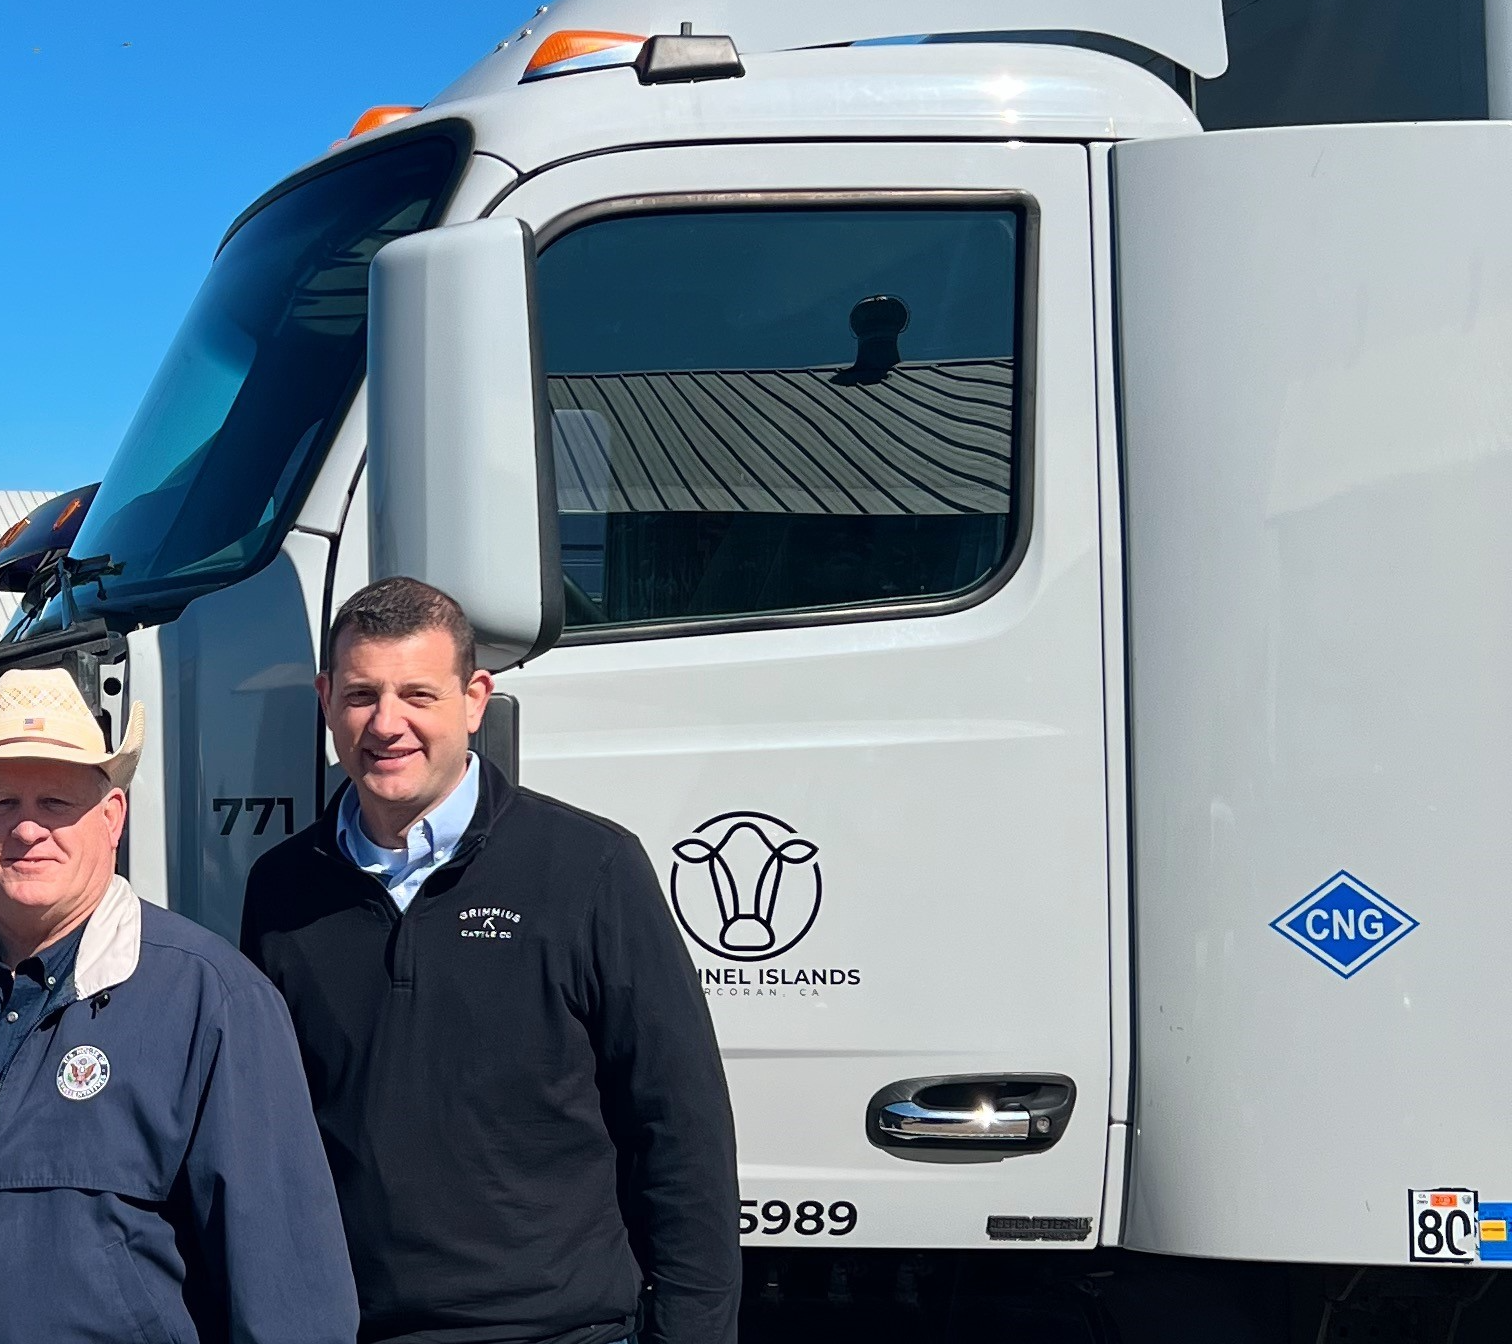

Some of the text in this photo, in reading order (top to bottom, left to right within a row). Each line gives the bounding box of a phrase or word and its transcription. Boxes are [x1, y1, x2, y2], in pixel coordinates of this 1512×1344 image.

[213, 797, 294, 836] 771
[460, 929, 497, 938] CATTLE
[1305, 908, 1384, 941] CNG
[759, 968, 861, 985] ISLANDS
[799, 988, 820, 997] CA
[739, 1200, 858, 1236] 5989
[1417, 1209, 1472, 1256] 80
